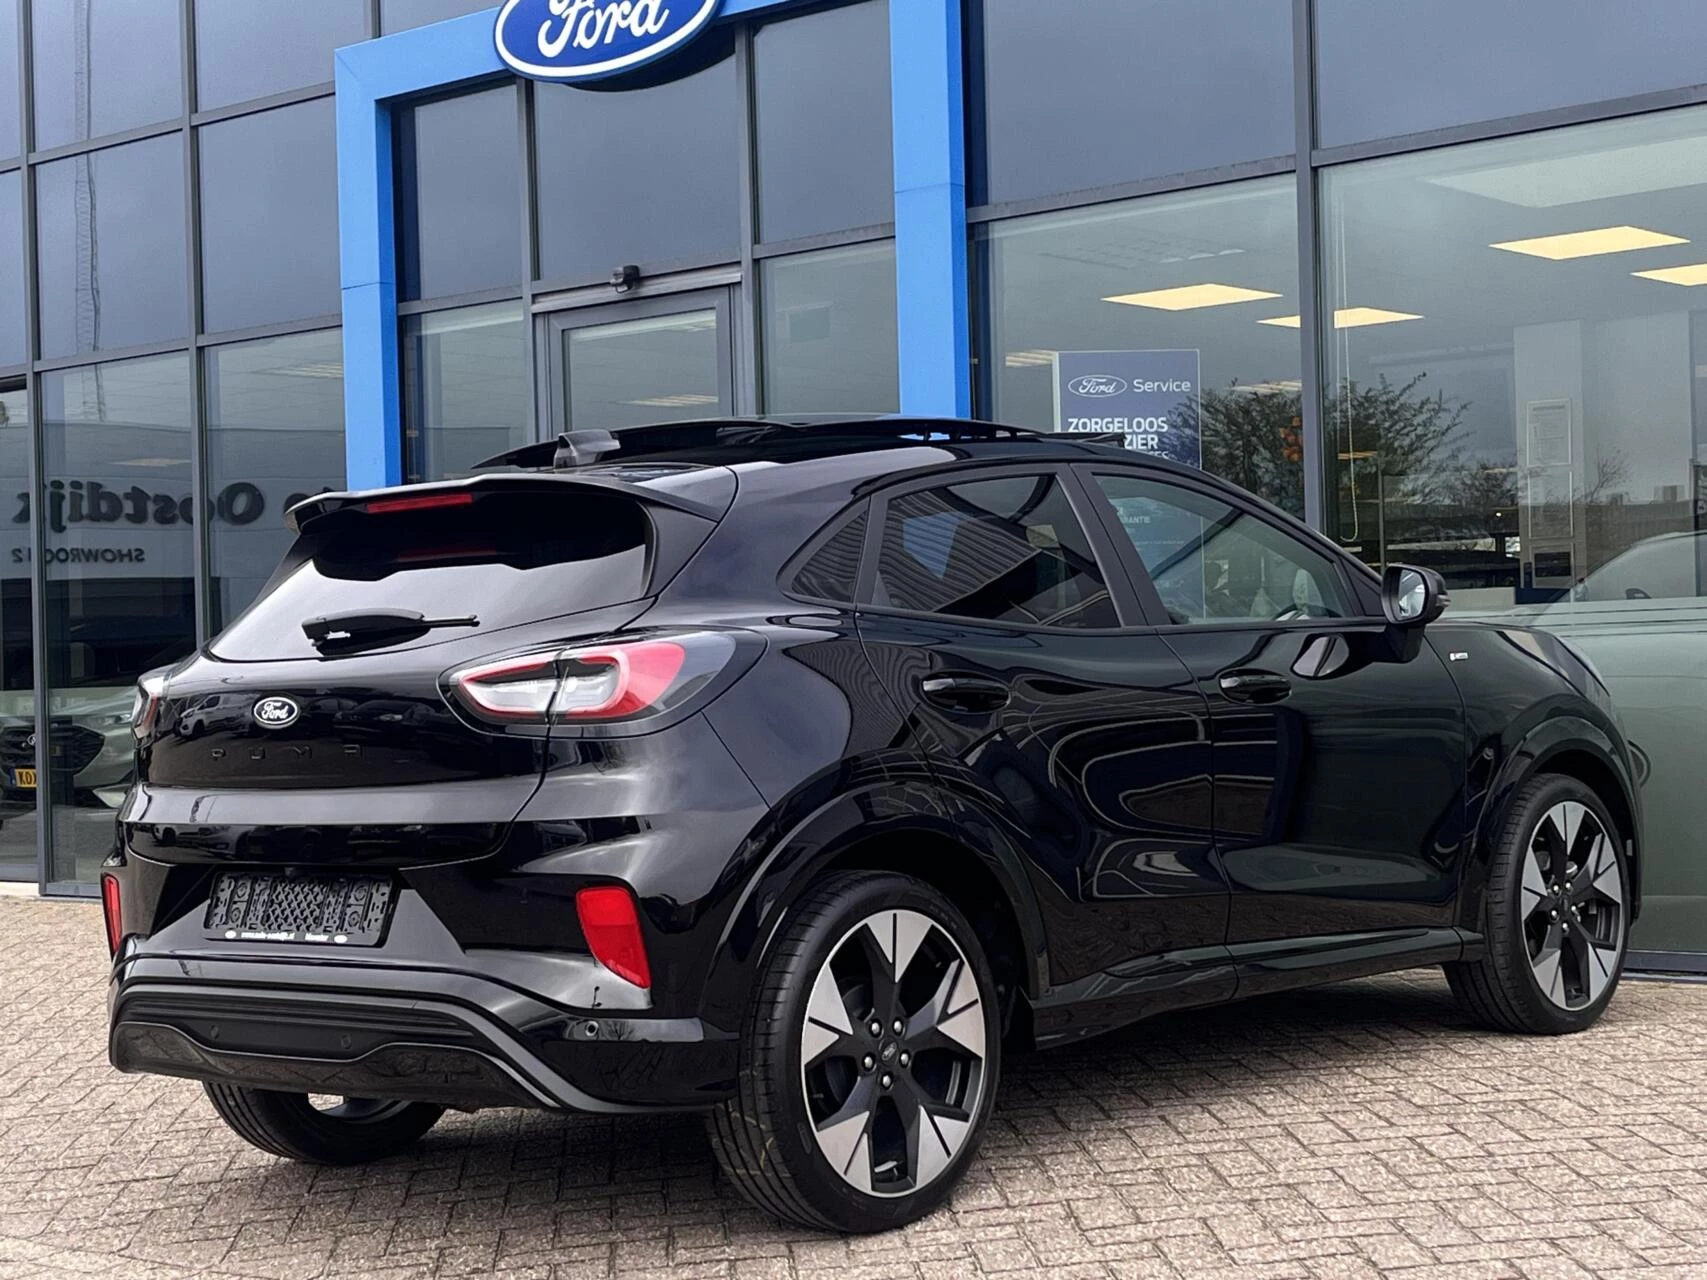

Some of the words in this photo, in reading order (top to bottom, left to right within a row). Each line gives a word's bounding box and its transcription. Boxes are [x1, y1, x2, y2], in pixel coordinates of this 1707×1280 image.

[537, 0, 670, 58] Ford
[1078, 377, 1118, 394] Ford
[1133, 378, 1192, 392] Service
[1067, 416, 1169, 433] ZORGELOOS
[261, 701, 289, 719] Ford
[210, 744, 361, 761] PUMA
